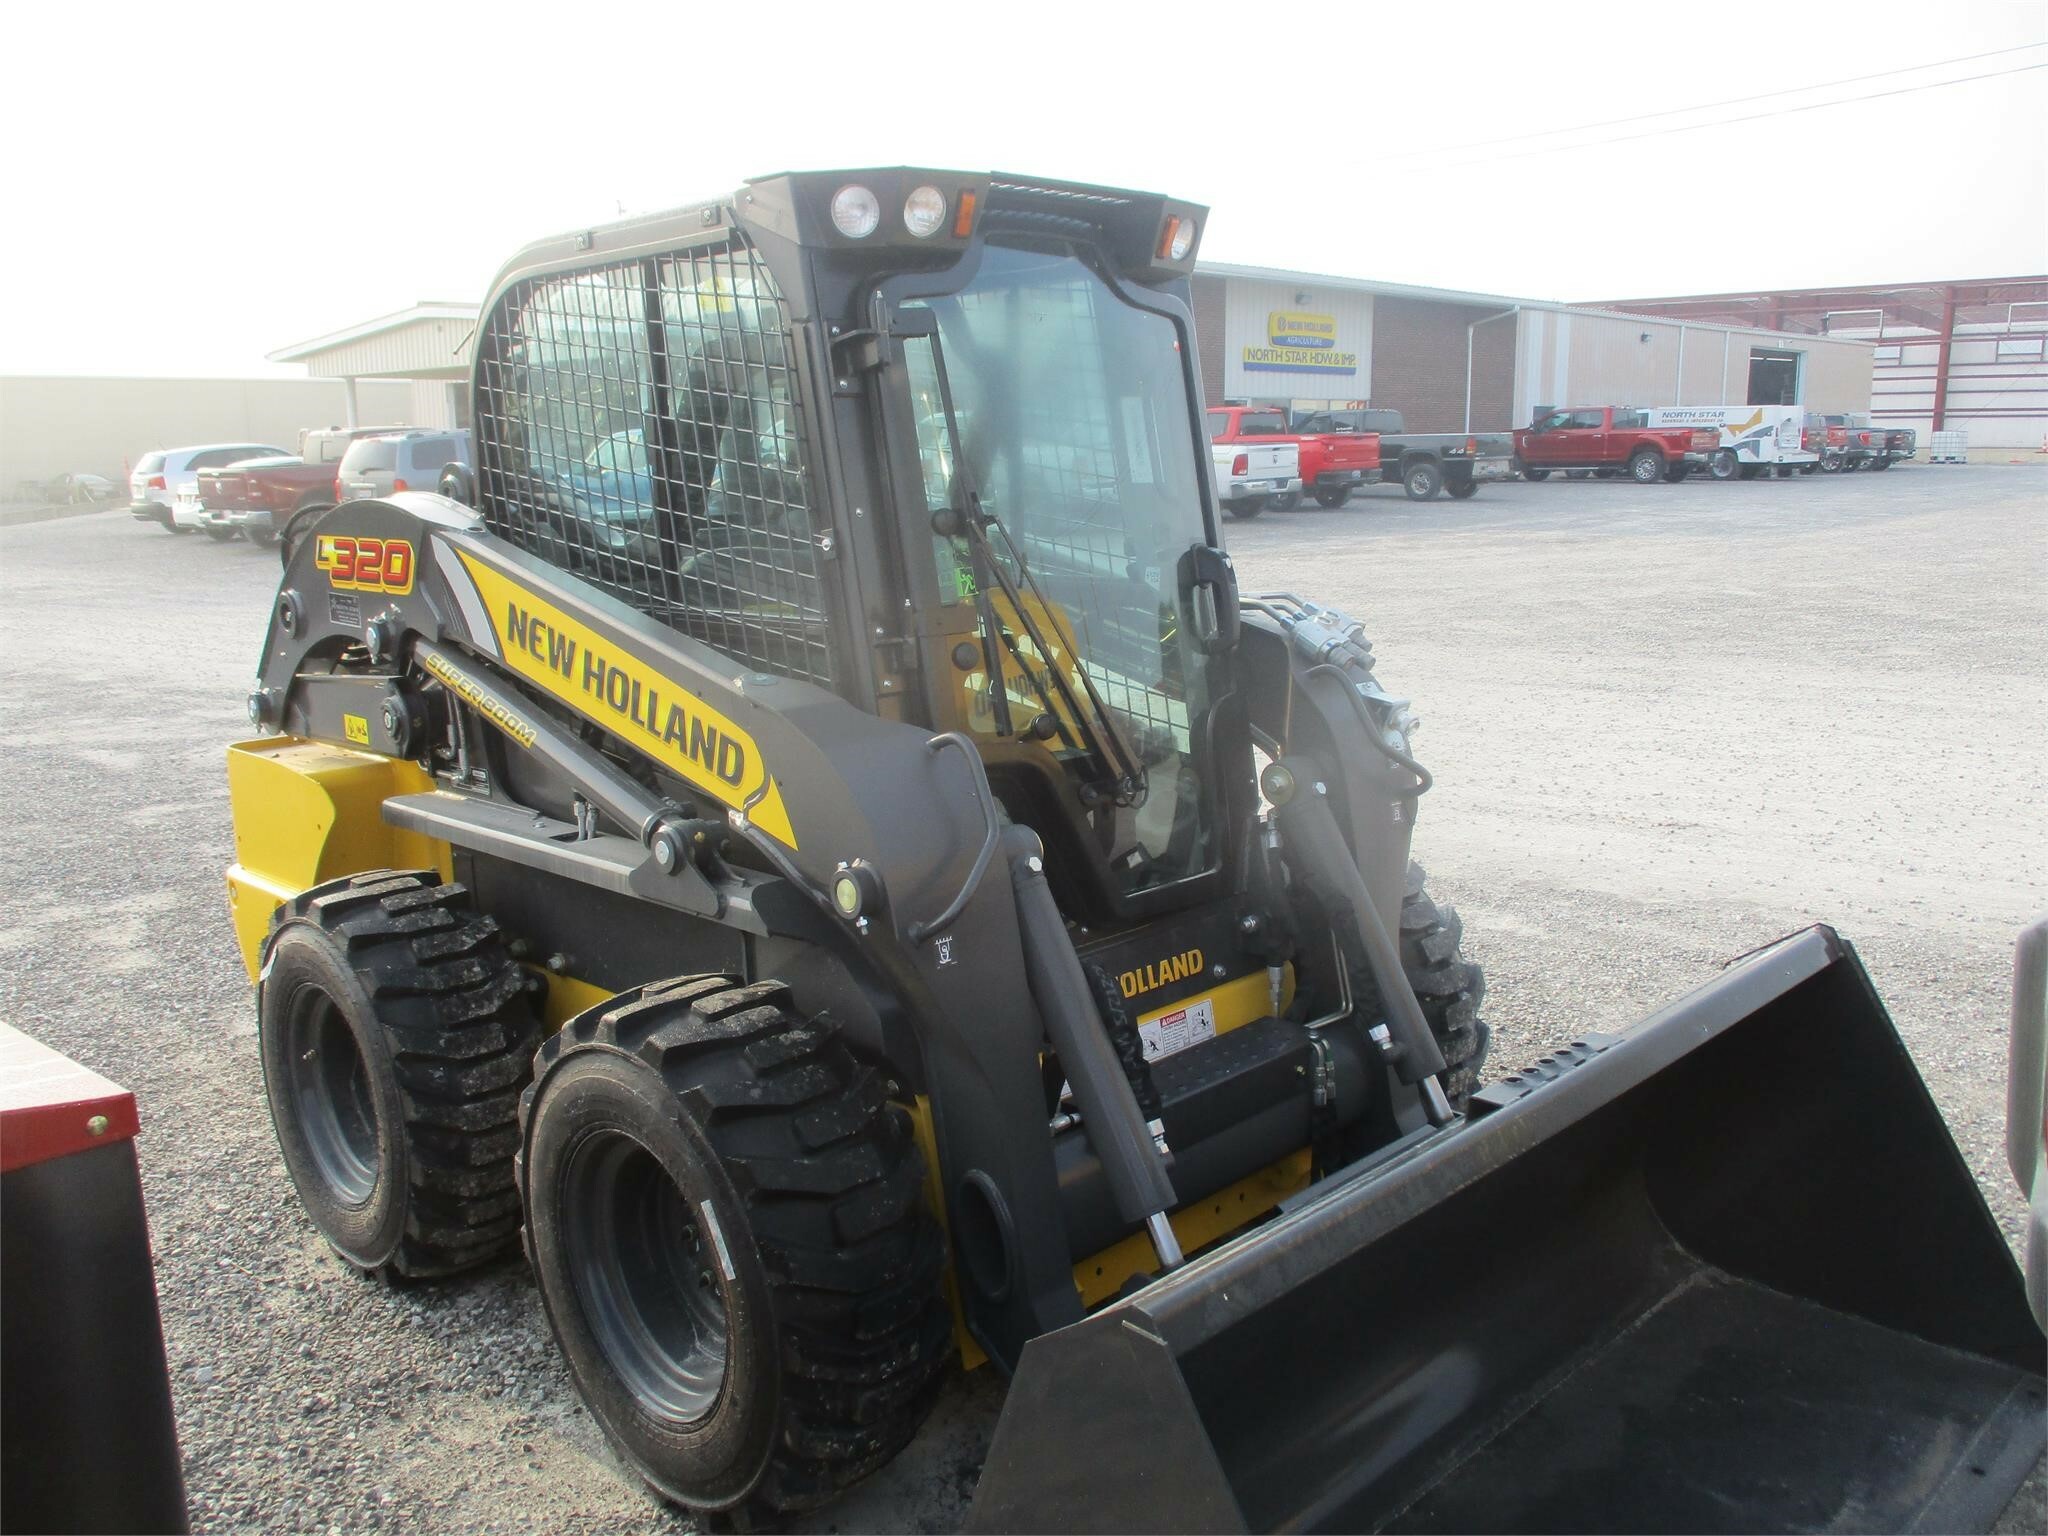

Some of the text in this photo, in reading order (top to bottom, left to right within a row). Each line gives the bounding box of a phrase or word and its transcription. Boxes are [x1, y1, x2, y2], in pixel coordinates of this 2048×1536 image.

[1248, 348, 1283, 362] NORTH
[1285, 350, 1308, 364] STAR
[1287, 336, 1322, 346] AGRICULTURE
[427, 654, 537, 747] SUPER BOOM
[507, 600, 746, 789] NEW HOLLAND
[1116, 949, 1204, 998] OLLAND
